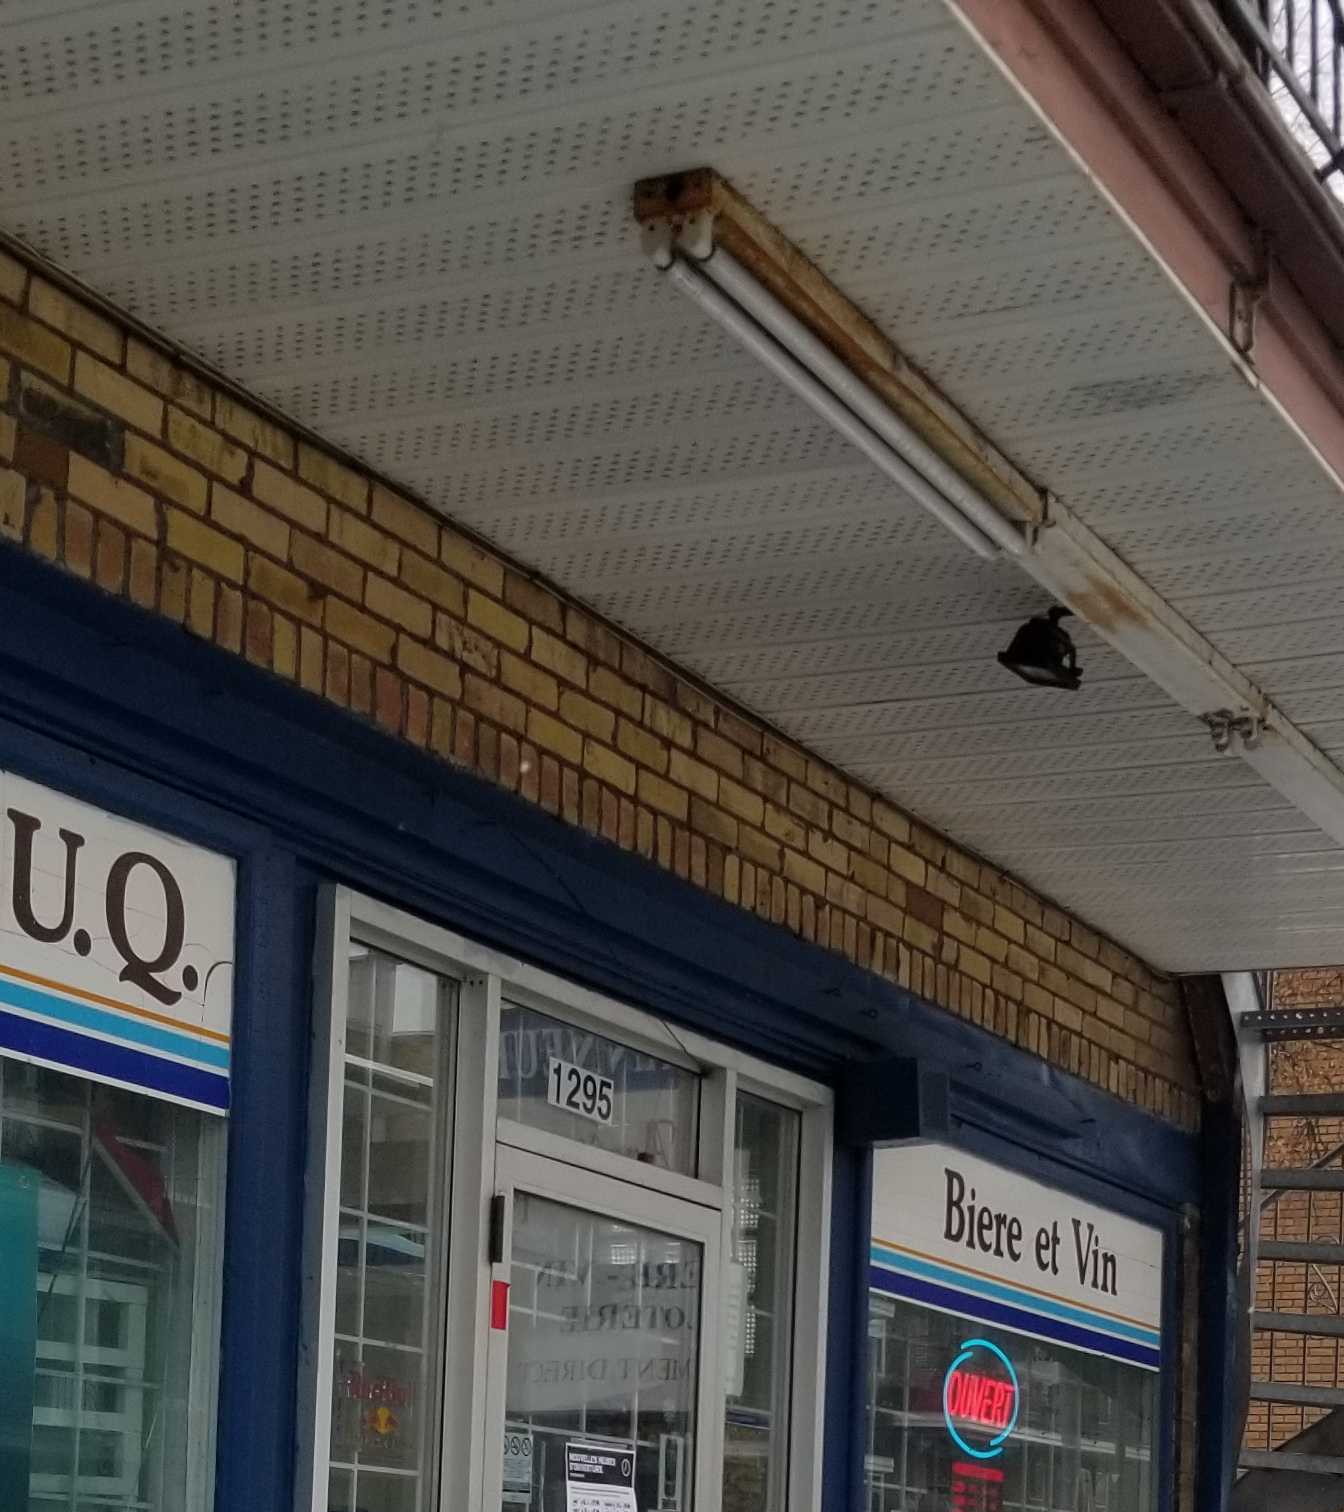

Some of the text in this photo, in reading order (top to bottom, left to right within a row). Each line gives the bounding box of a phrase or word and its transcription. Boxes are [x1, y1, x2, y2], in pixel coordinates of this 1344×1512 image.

[553, 1062, 612, 1121] 1295
[1035, 1220, 1061, 1275] et
[1072, 1217, 1119, 1296] Vin
[948, 1371, 1014, 1429] OUVERT
